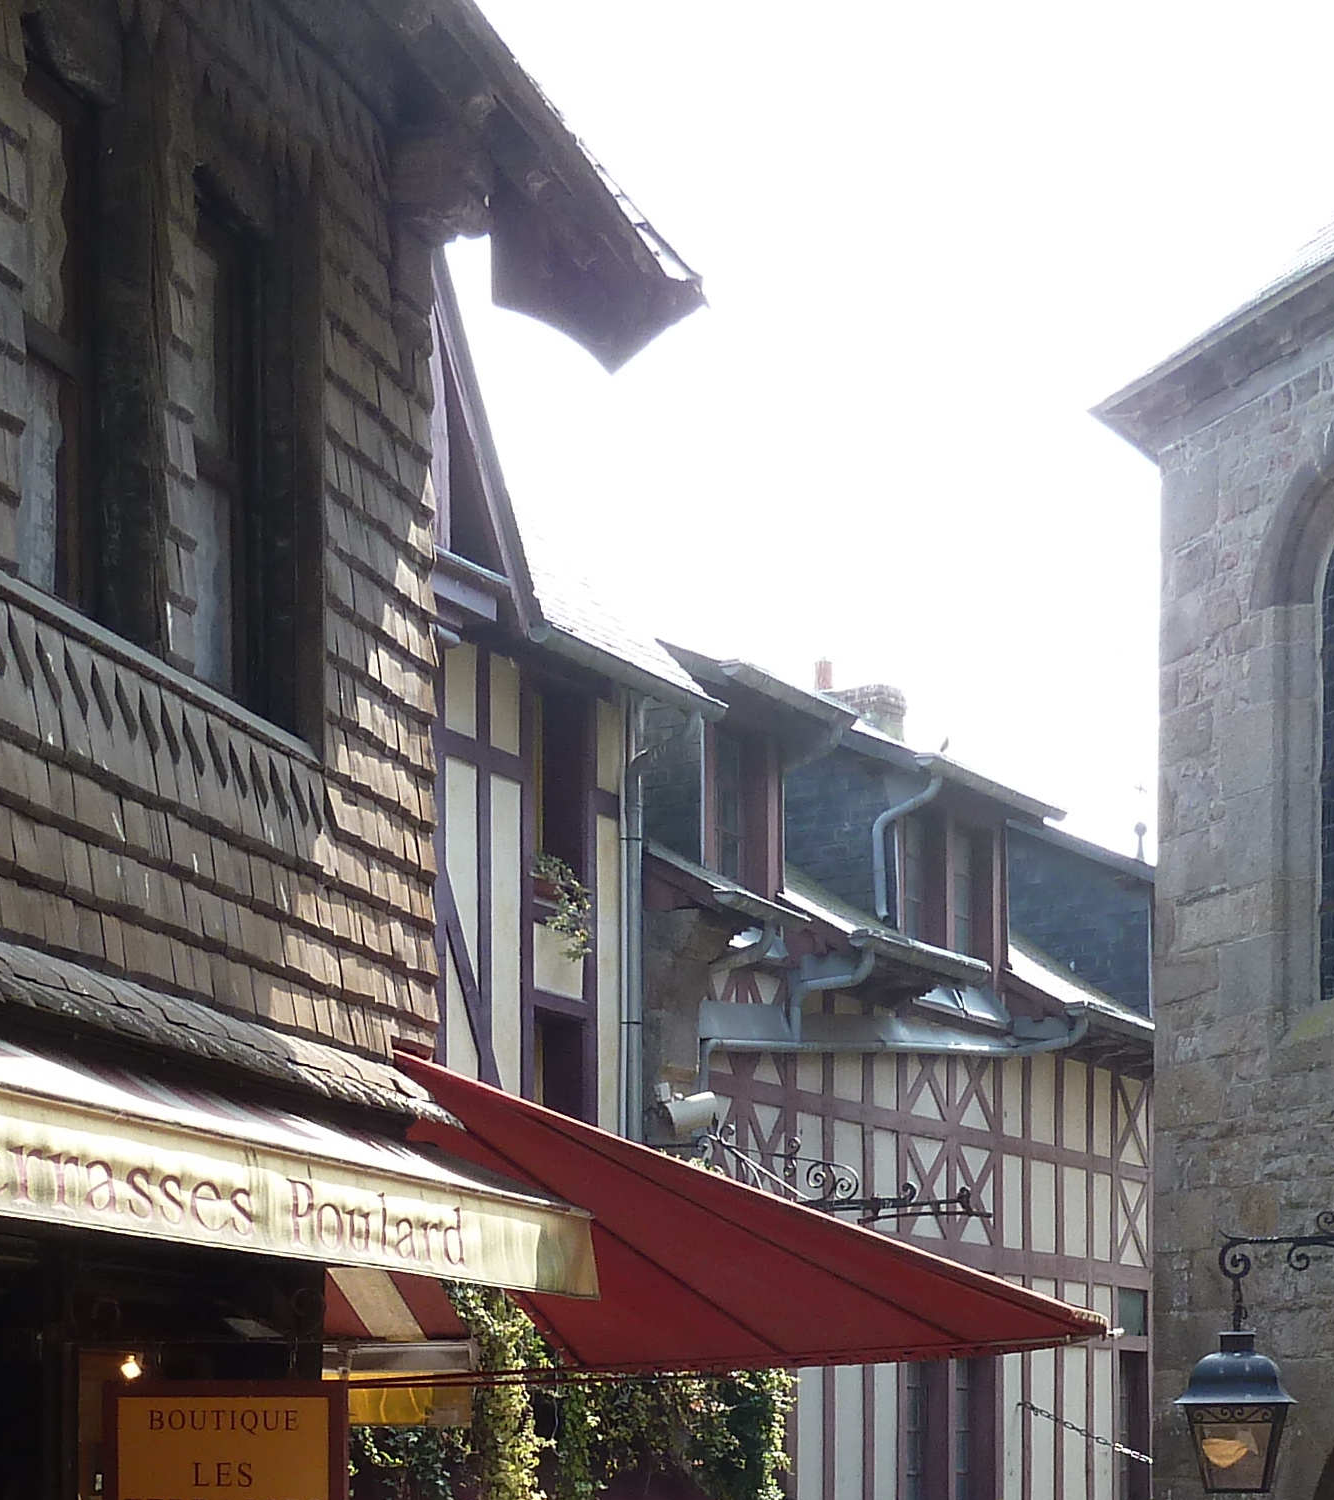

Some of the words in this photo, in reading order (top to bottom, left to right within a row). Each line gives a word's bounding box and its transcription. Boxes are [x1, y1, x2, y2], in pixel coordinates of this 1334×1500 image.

[288, 1177, 467, 1267] Poulard
[149, 1410, 300, 1434] BOUTIQUE
[192, 1462, 254, 1488] LES
